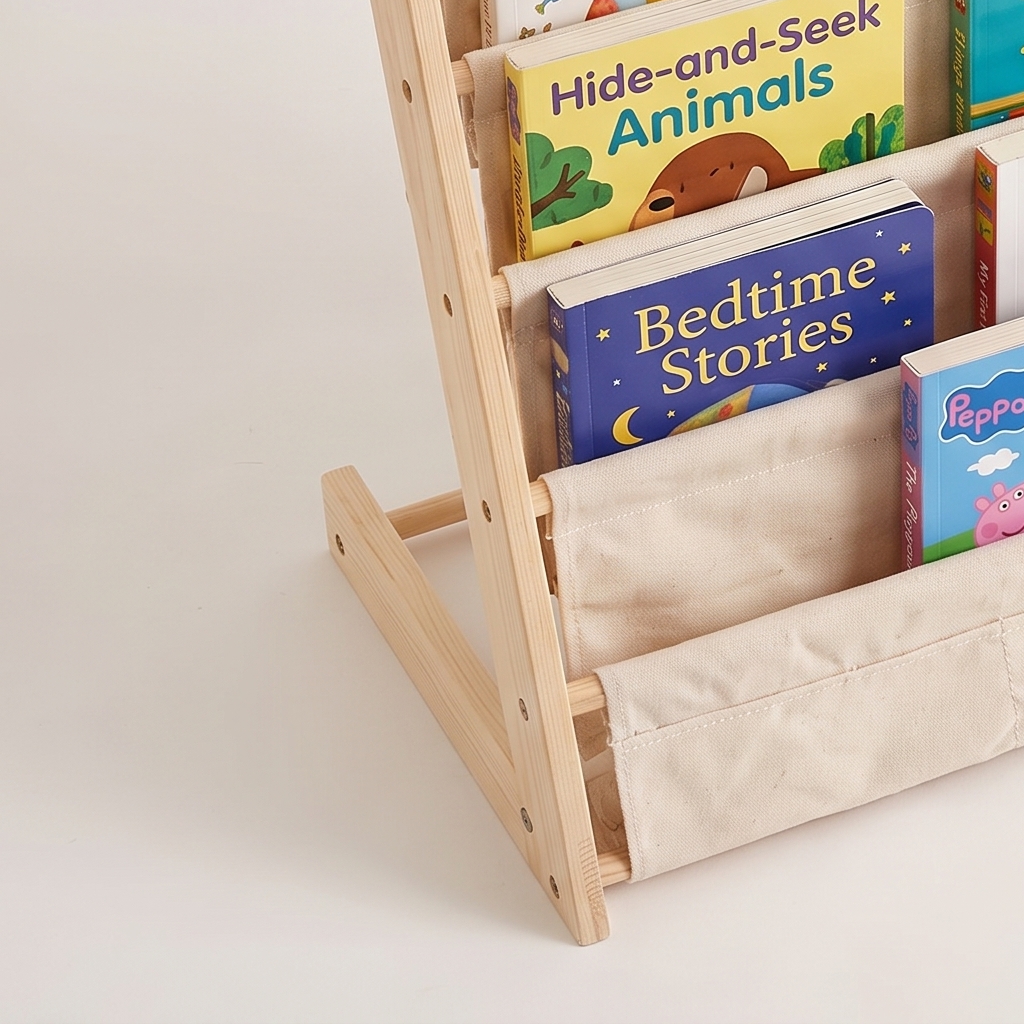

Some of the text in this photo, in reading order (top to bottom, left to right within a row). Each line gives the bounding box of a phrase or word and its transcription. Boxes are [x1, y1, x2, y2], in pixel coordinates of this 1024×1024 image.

[607, 57, 834, 156] Animals
[633, 256, 877, 356] Bedtime
[661, 311, 854, 395] Stories
